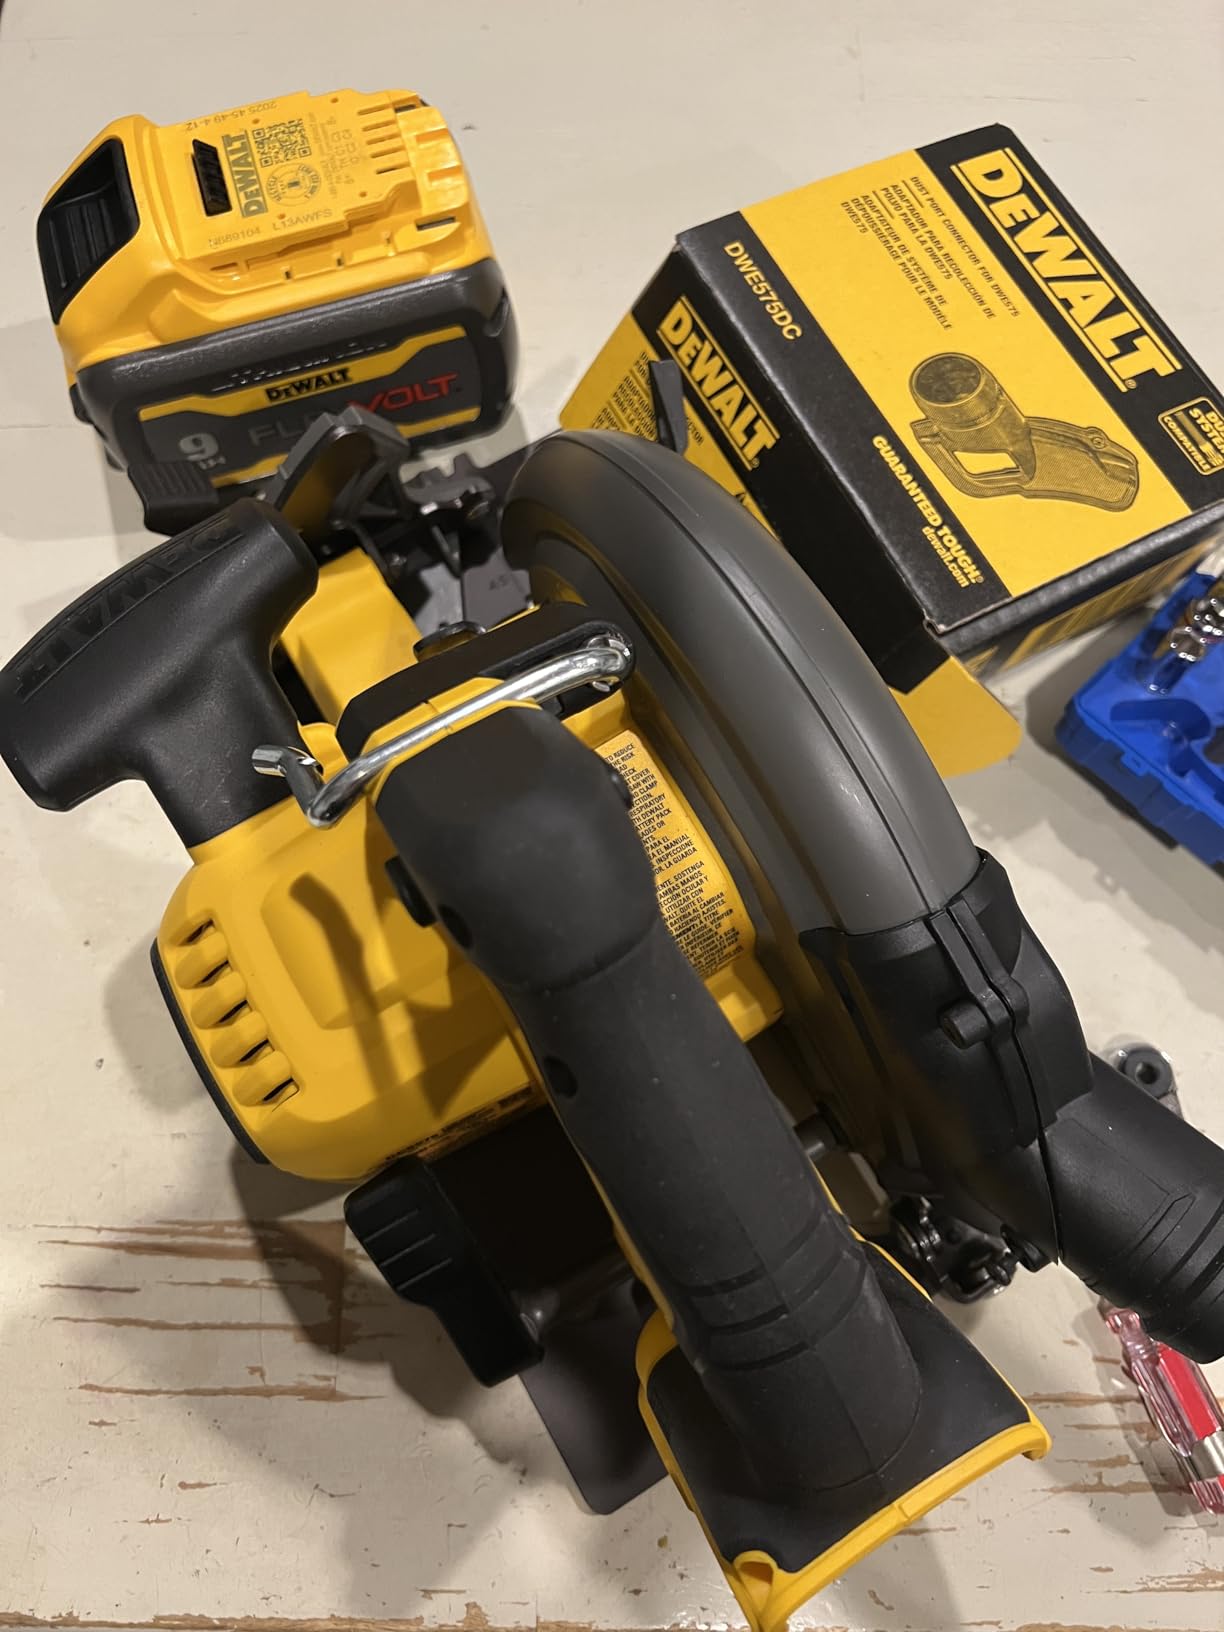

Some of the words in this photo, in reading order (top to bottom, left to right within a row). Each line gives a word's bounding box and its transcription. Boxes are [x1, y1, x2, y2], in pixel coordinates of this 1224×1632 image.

[223, 132, 267, 217] DEWALT
[860, 193, 901, 243] ADAPTATEUR
[879, 186, 903, 212] POLVO
[898, 211, 919, 234] PARA
[889, 182, 929, 229] ADAPTADOR
[923, 229, 946, 252] PARA
[909, 175, 930, 197] DUST
[924, 196, 946, 219] PORT
[940, 217, 982, 266] CONNECTOR
[976, 265, 995, 283] FOR
[896, 261, 919, 285] POUR
[955, 149, 1175, 389] DEWALT
[723, 239, 804, 342] DWE575DC
[266, 367, 352, 402] DEWALT
[659, 303, 775, 461] DEWALT
[179, 433, 220, 462] 9
[869, 433, 945, 528] GUARANTEED
[920, 524, 971, 588] dewalt.com
[612, 743, 634, 758] REDUCE
[631, 767, 650, 781] COVER
[638, 779, 658, 794] CLAMP
[641, 773, 655, 784] WITH
[640, 802, 665, 819] DEWALT
[655, 807, 671, 819] PACK
[654, 839, 693, 865] INSPECCIONE
[663, 832, 689, 850] MANUAL
[672, 845, 697, 864] GUARDA
[654, 878, 672, 892] ENTE.
[672, 859, 704, 881] SOSTENGA
